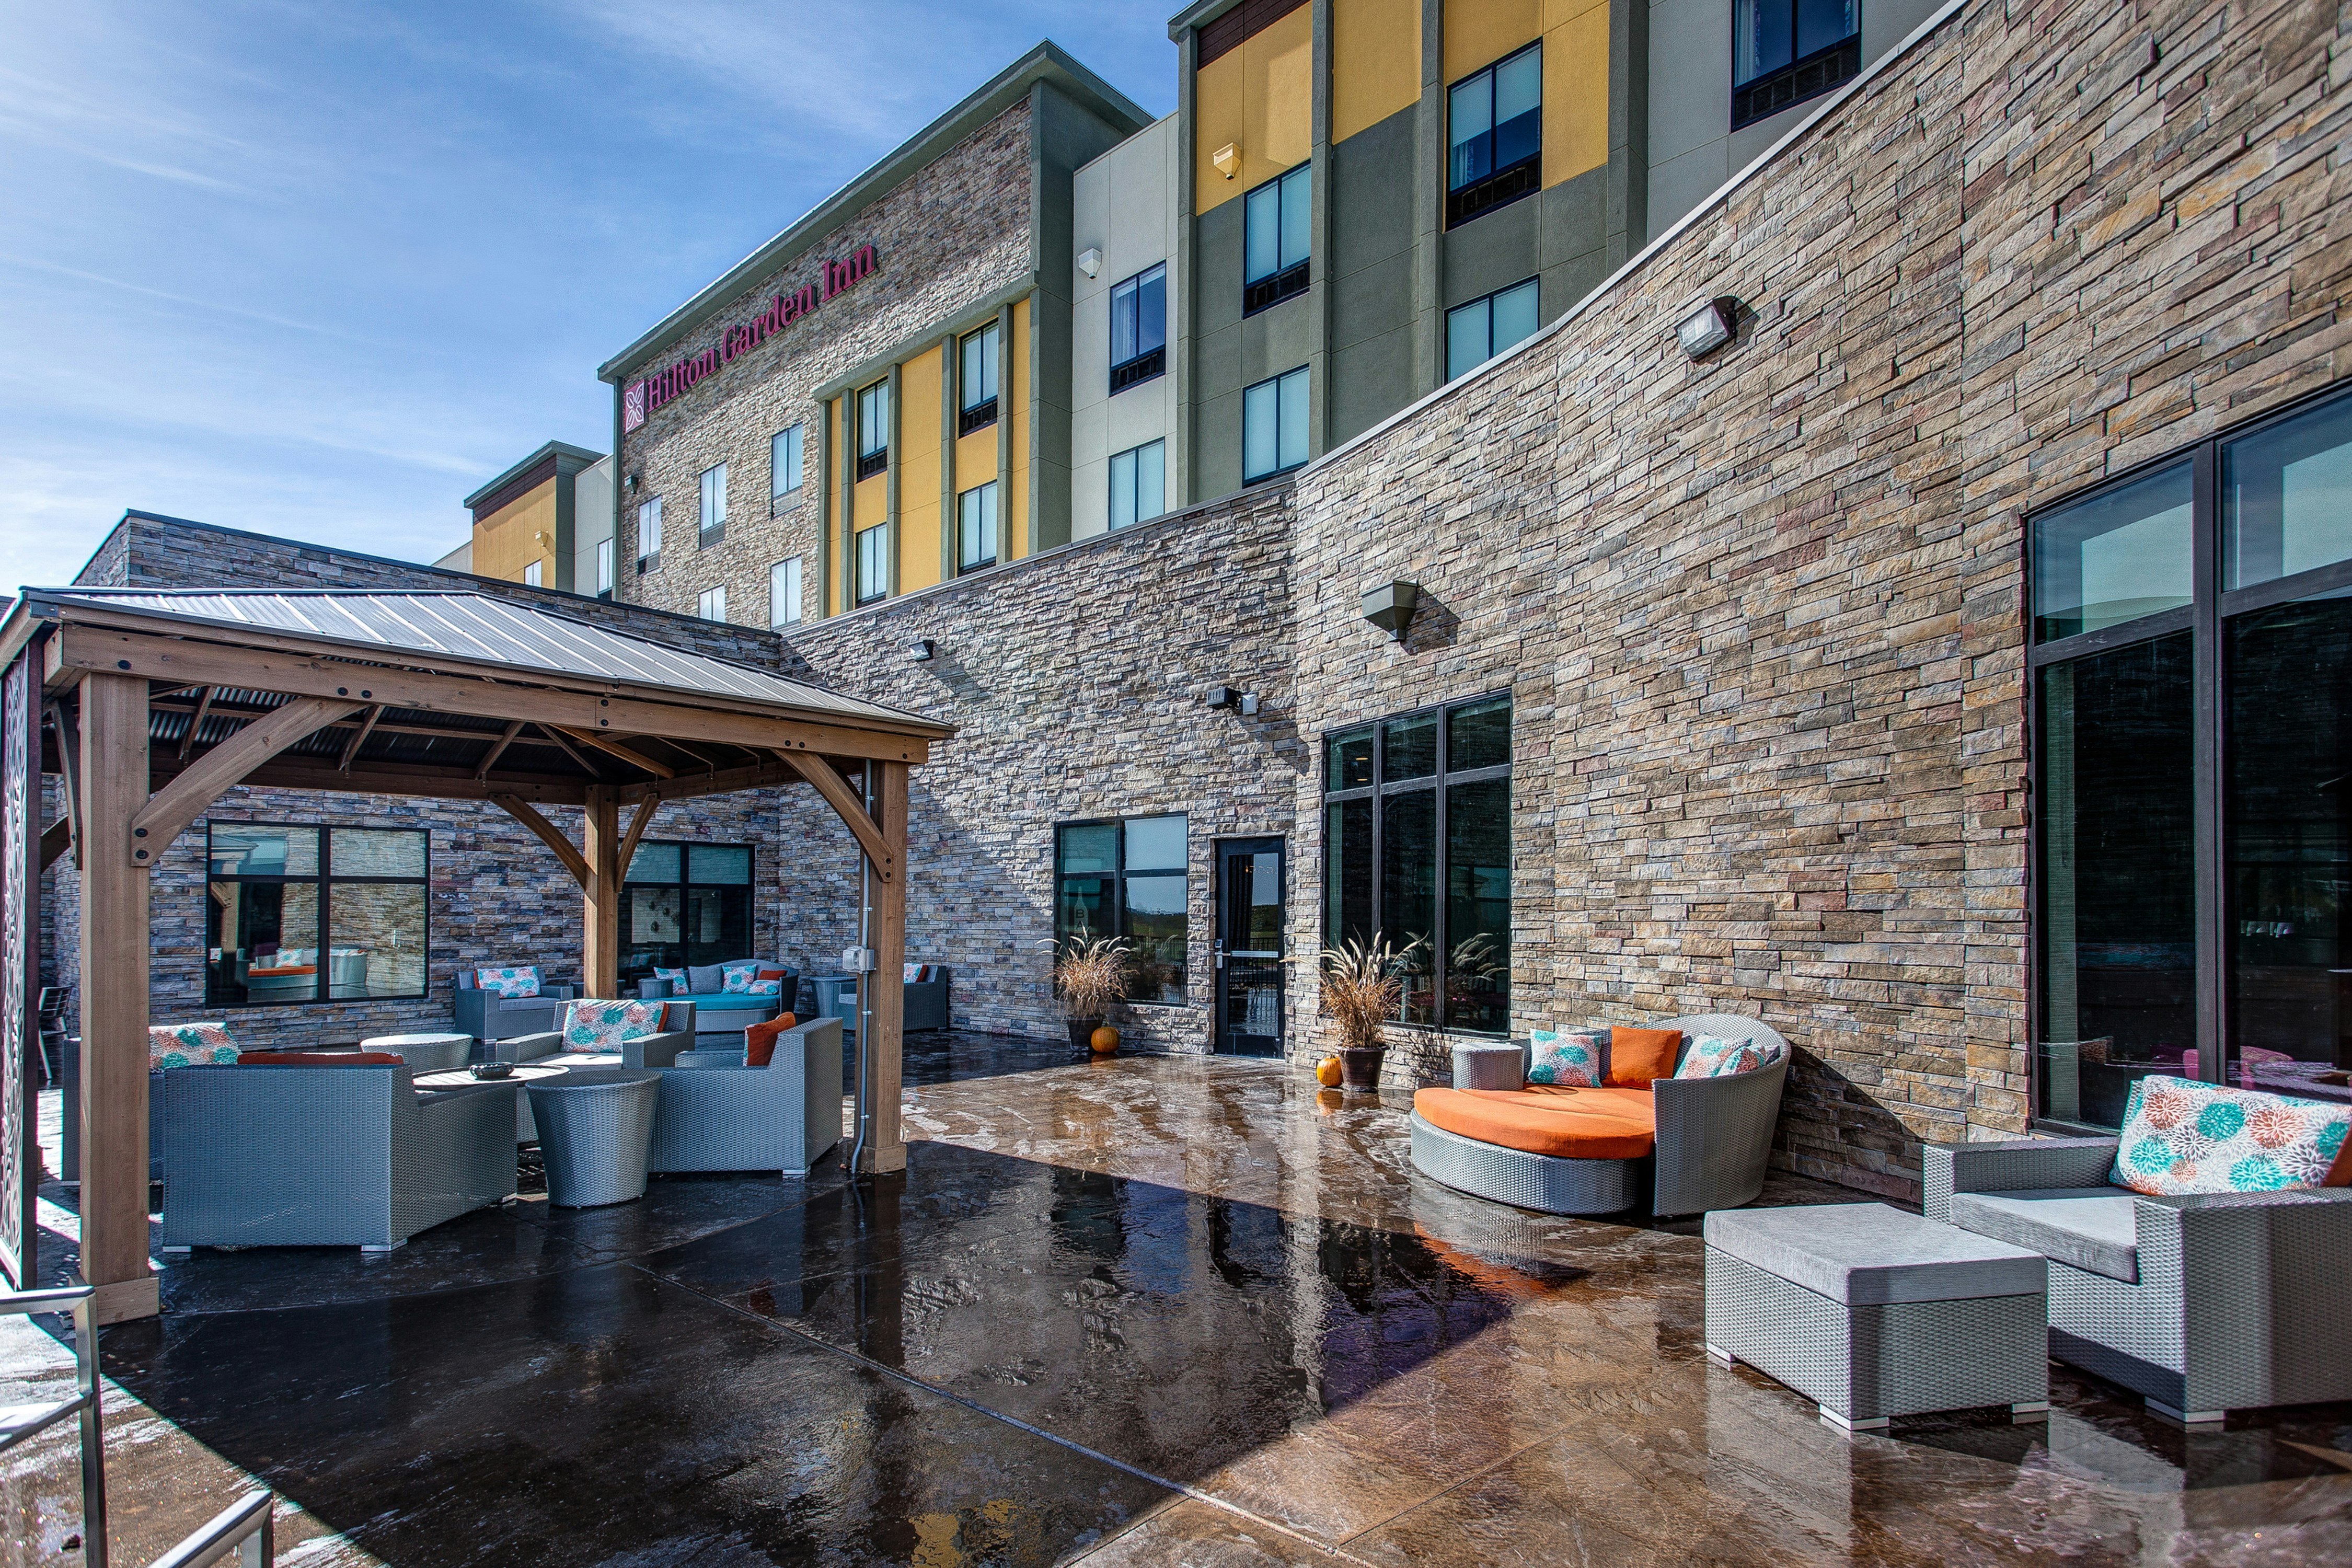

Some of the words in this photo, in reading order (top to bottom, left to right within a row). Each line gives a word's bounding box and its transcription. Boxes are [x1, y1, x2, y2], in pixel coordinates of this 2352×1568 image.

[648, 348, 718, 413] Hilton
[722, 284, 814, 363] Garden
[822, 244, 876, 303] Inn
